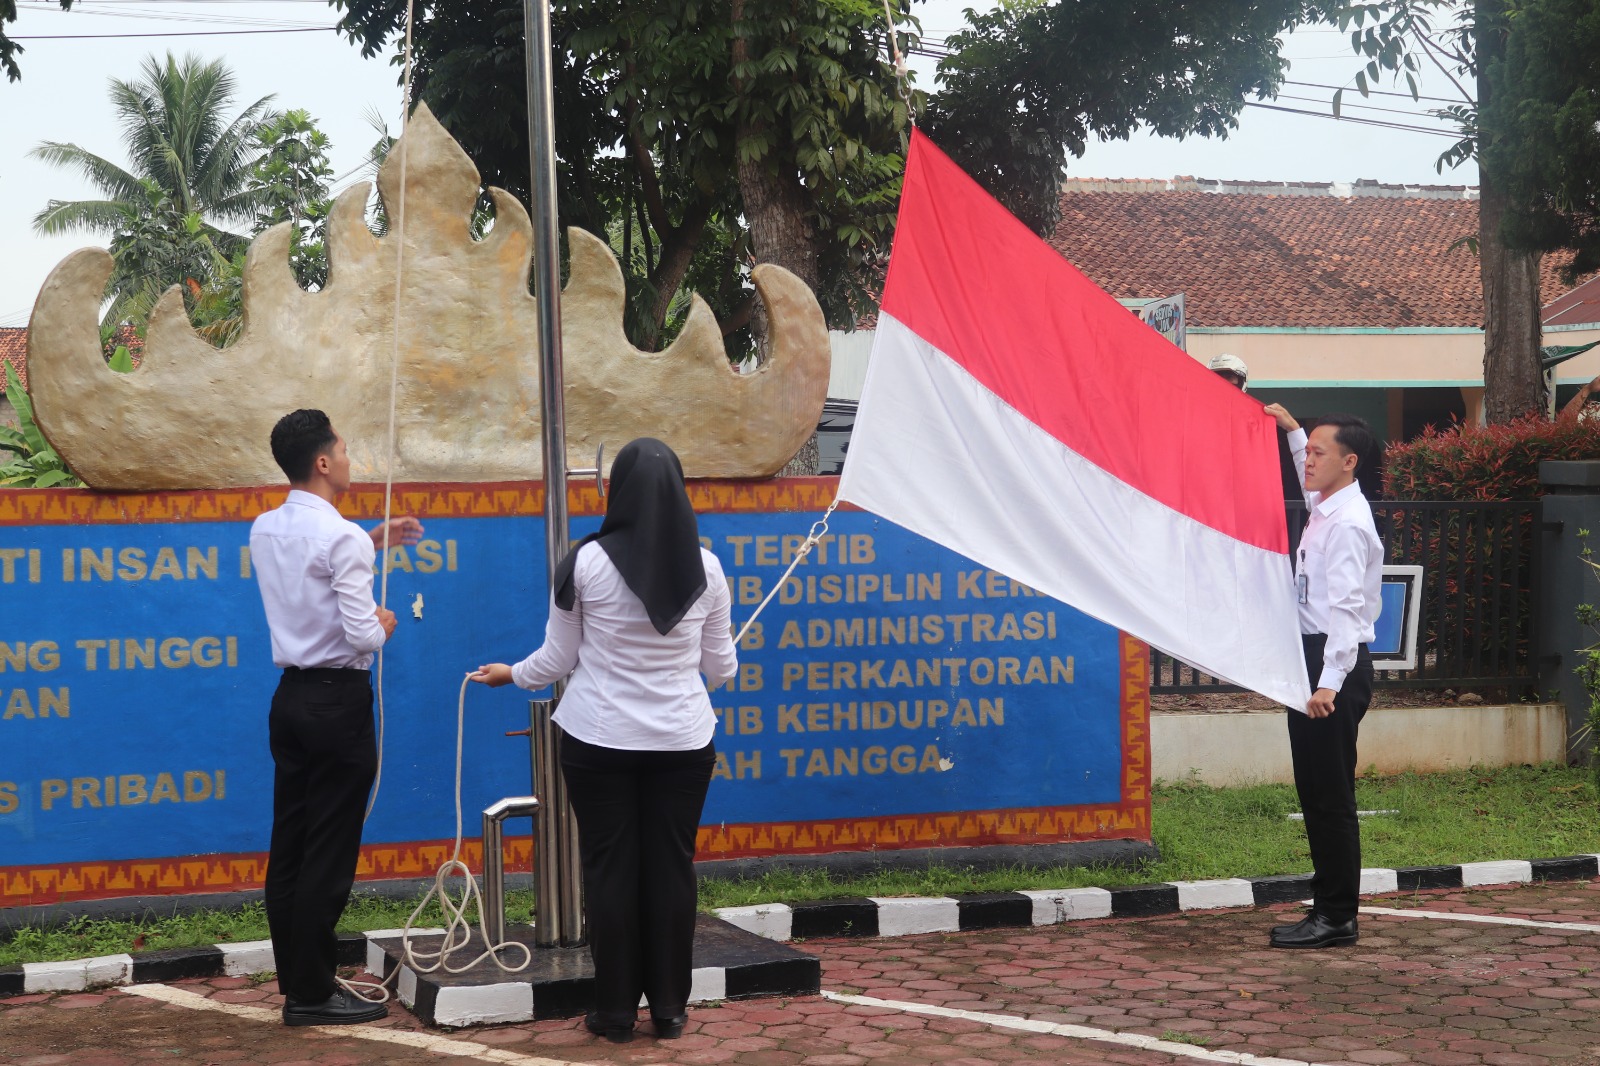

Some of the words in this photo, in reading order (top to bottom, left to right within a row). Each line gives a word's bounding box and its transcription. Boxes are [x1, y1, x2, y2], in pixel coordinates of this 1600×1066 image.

[63, 547, 218, 581] INSAN
[726, 534, 876, 566] TERTIB
[779, 572, 942, 605] DISIPLIN
[957, 569, 1047, 599] KER
[778, 611, 1057, 650] ADMINISTRASI
[76, 636, 238, 671] TINGGI
[783, 656, 1075, 692] PERKANTORAN
[777, 697, 1004, 734] KEHIDUPAN
[779, 745, 943, 778] TANGGA
[41, 769, 226, 811] PRIBADI
